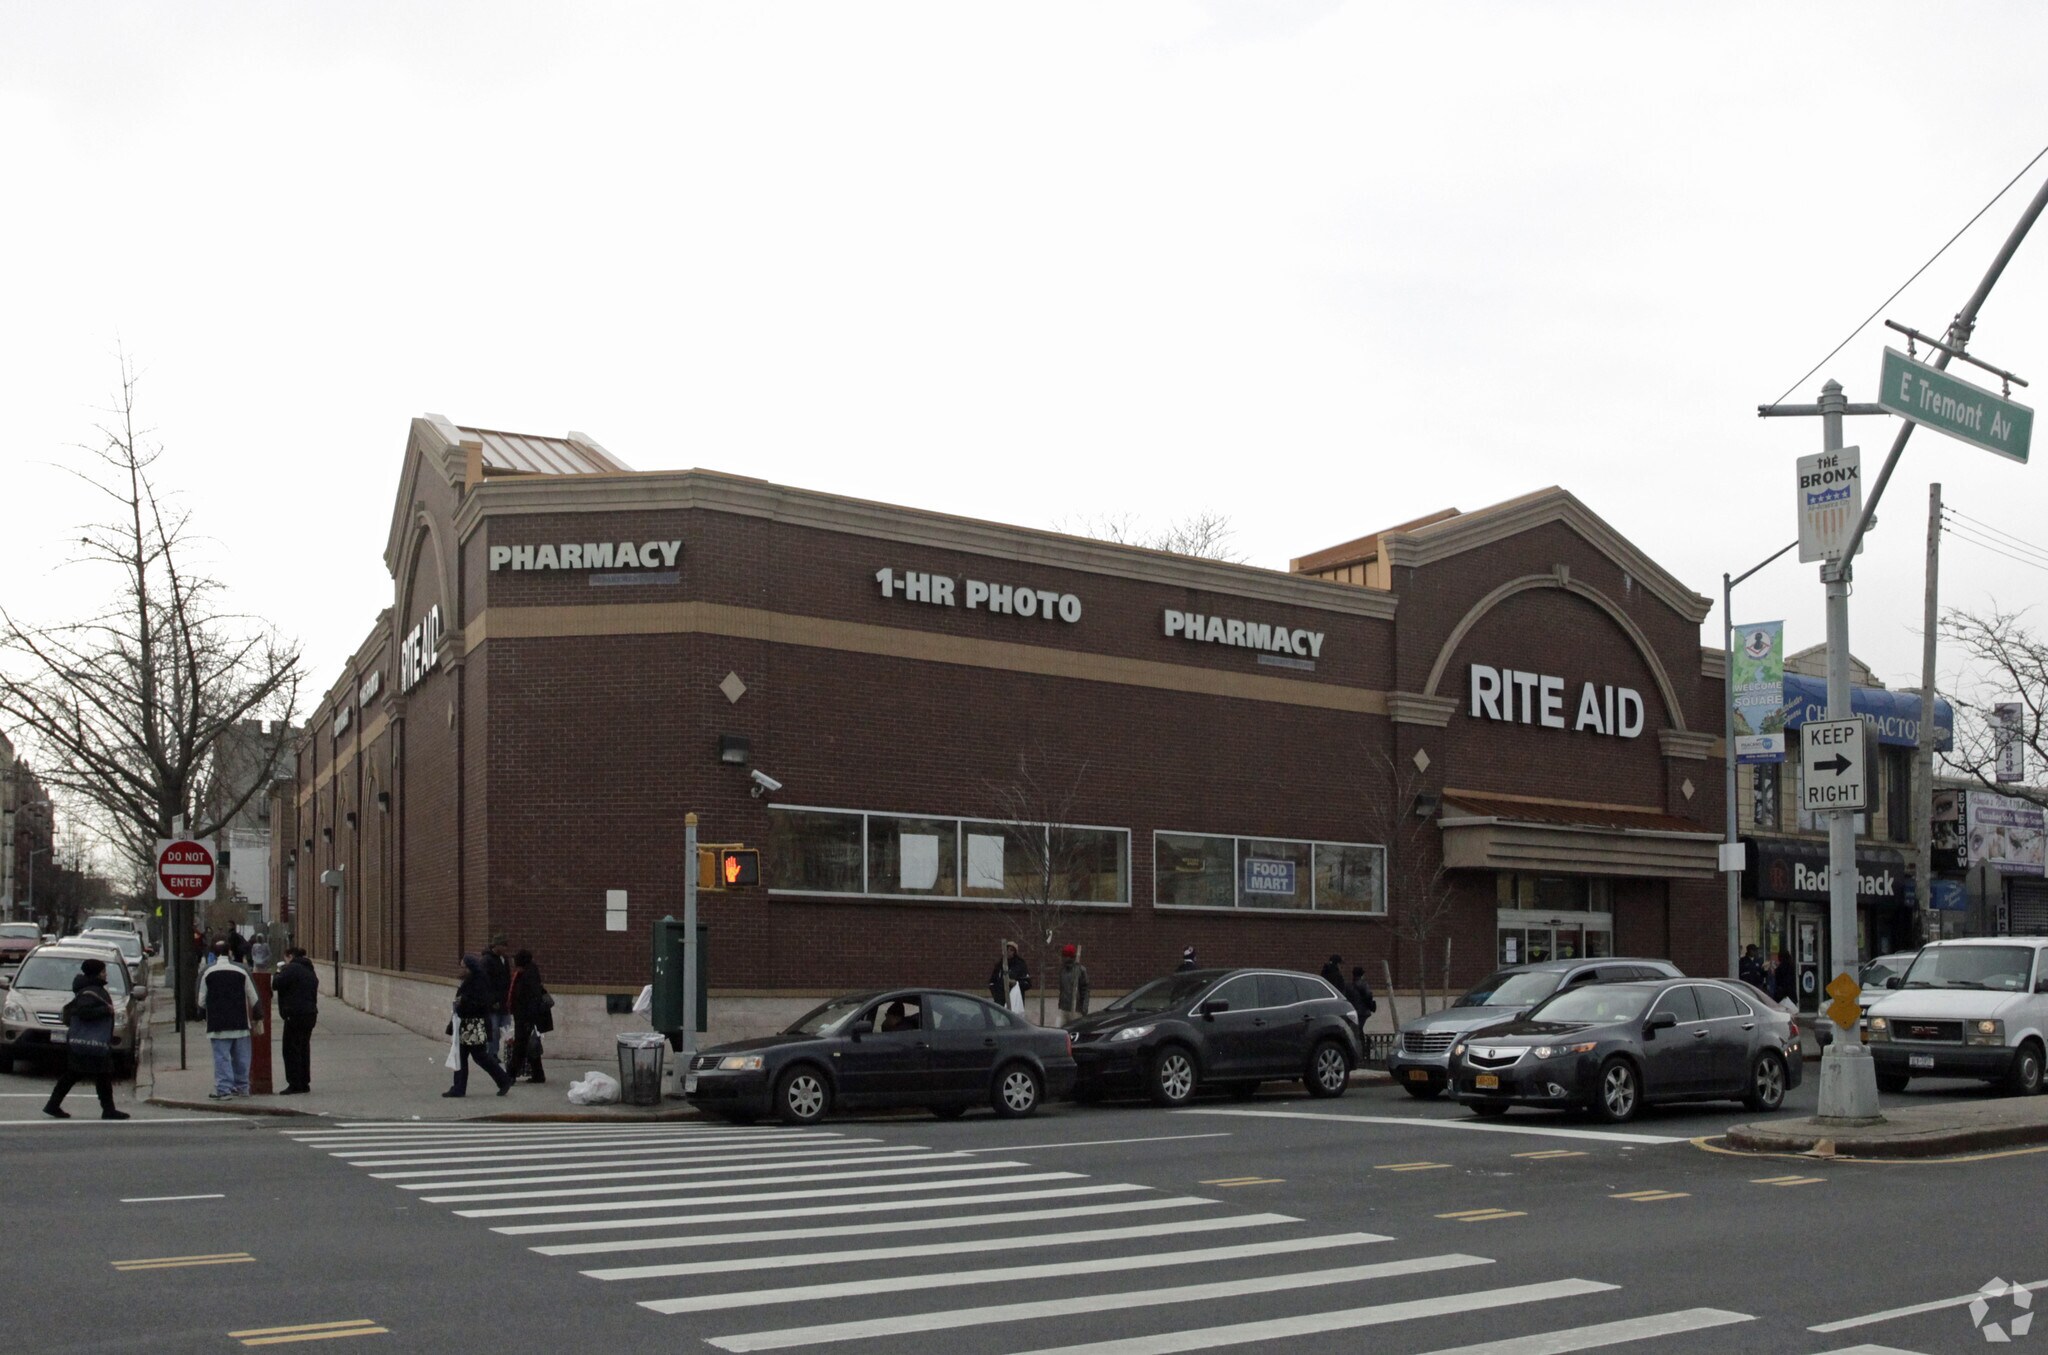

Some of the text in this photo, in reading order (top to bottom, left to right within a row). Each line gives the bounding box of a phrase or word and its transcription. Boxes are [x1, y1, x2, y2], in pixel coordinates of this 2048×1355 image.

[1900, 371, 2012, 441] E Tremont Av
[1817, 455, 1839, 470] THE
[1800, 466, 1858, 489] BRONX
[489, 540, 682, 571] PHARMACY
[875, 567, 1082, 623] 1-HR PHOTO
[1164, 609, 1325, 657] PHARMACY
[401, 623, 420, 696] RITE
[421, 604, 439, 676] AID
[1734, 681, 1783, 692] WELCOME
[1470, 663, 1645, 739] RITE AID
[1734, 695, 1783, 707] SQUARE
[1811, 727, 1855, 746] KEEP
[1809, 784, 1859, 803] RIGHT
[1957, 791, 1968, 868] EYEBROW
[168, 851, 204, 862] DO NOT
[1253, 862, 1287, 877] FOOD
[1794, 863, 1895, 896] Radhack
[171, 877, 202, 888] ENTER
[1251, 876, 1289, 890] MART
